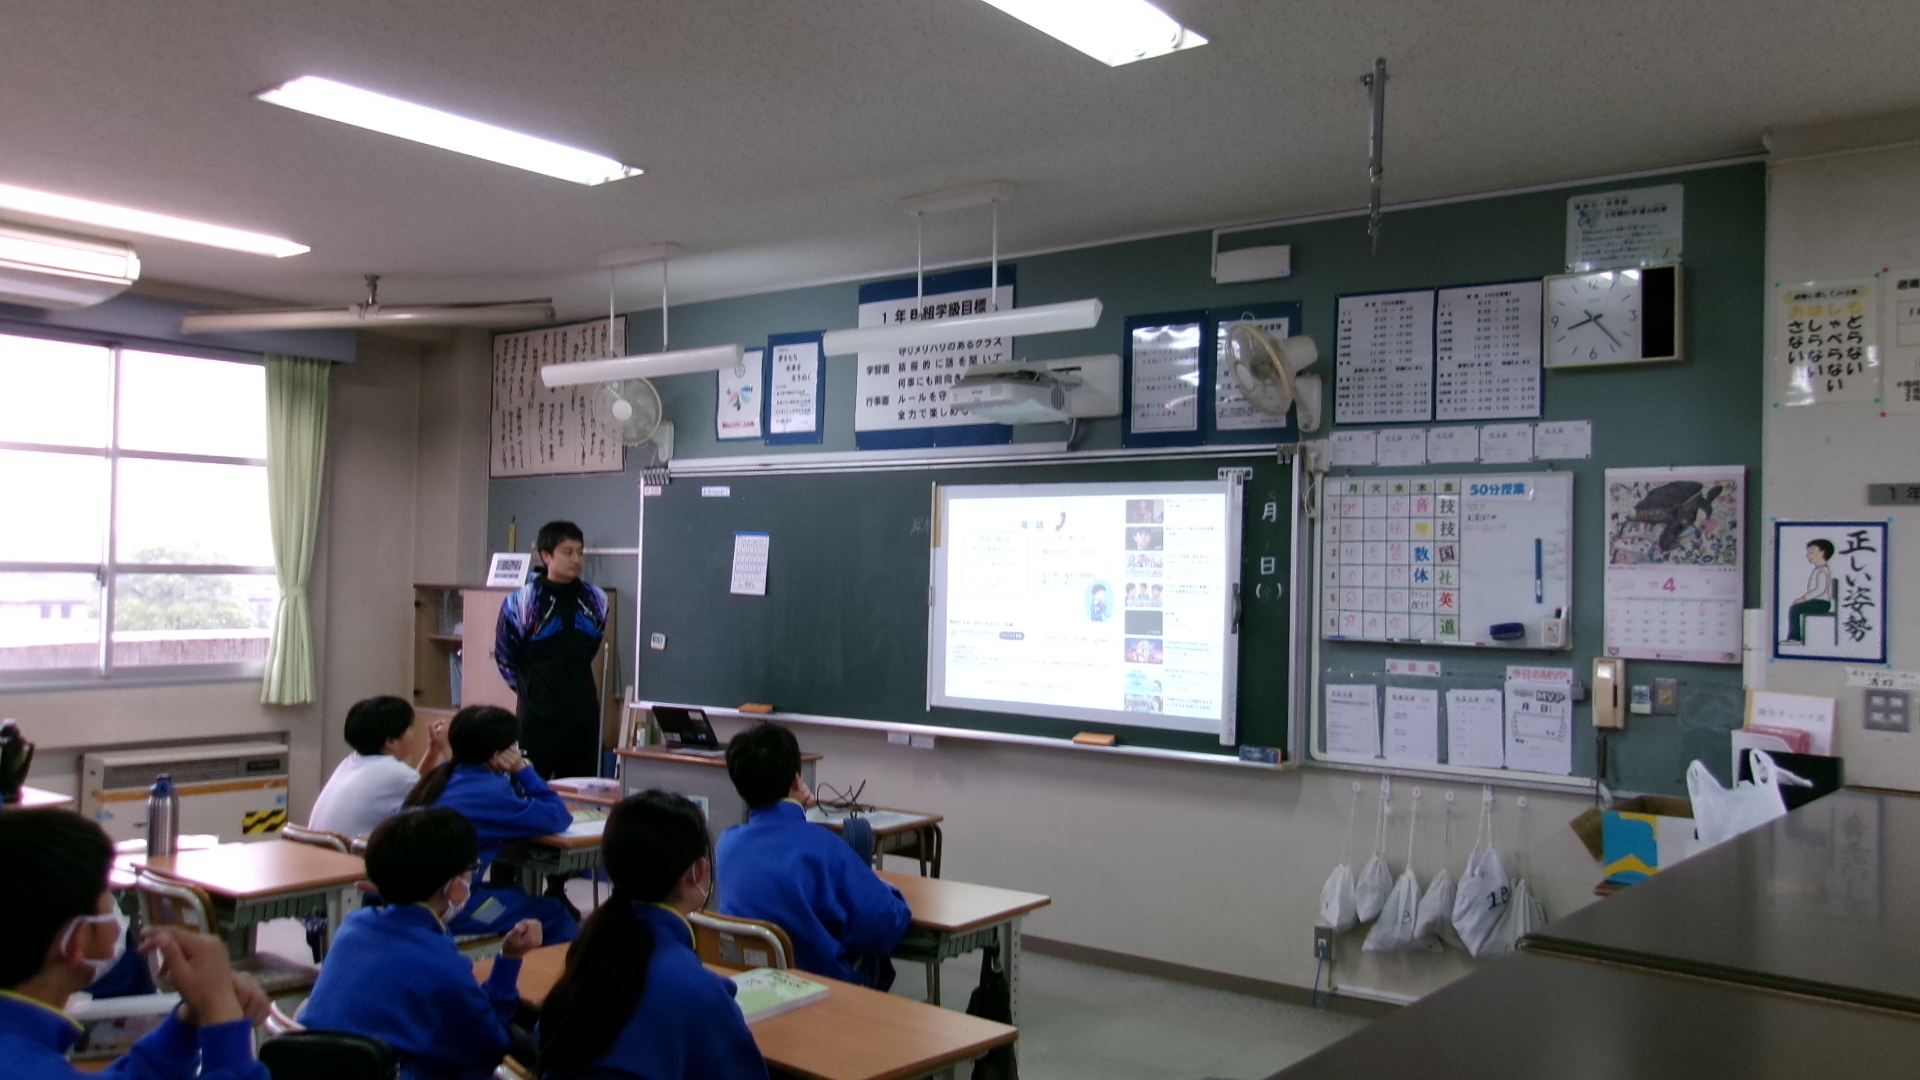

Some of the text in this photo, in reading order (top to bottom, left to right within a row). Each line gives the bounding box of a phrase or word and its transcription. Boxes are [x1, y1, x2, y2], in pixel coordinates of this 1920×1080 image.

[1588, 280, 1598, 290] 12
[1551, 315, 1559, 328] 9
[1629, 310, 1637, 321] 3
[1589, 348, 1597, 360] 6
[1826, 303, 1844, 392] しゃべらない
[1348, 484, 1358, 493] 月
[1372, 484, 1381, 493] 火
[1394, 483, 1404, 493] 水
[1417, 483, 1427, 493] 木
[1470, 482, 1525, 496] 50分授業
[1262, 502, 1277, 522] 月
[1414, 498, 1429, 513] 音
[1439, 499, 1455, 514] 技
[1440, 521, 1455, 537] 技
[1414, 546, 1430, 562] 数
[1439, 545, 1455, 562] 国
[1260, 556, 1276, 575] 日
[1414, 567, 1429, 583] 体
[1439, 569, 1453, 585] 社
[1661, 577, 1677, 592] 4
[1838, 530, 1877, 642] 正しい姿勢
[1438, 592, 1453, 608] 英
[1440, 618, 1456, 635] 道
[1512, 669, 1567, 681] 今日のMVP
[1535, 690, 1565, 703] MVP
